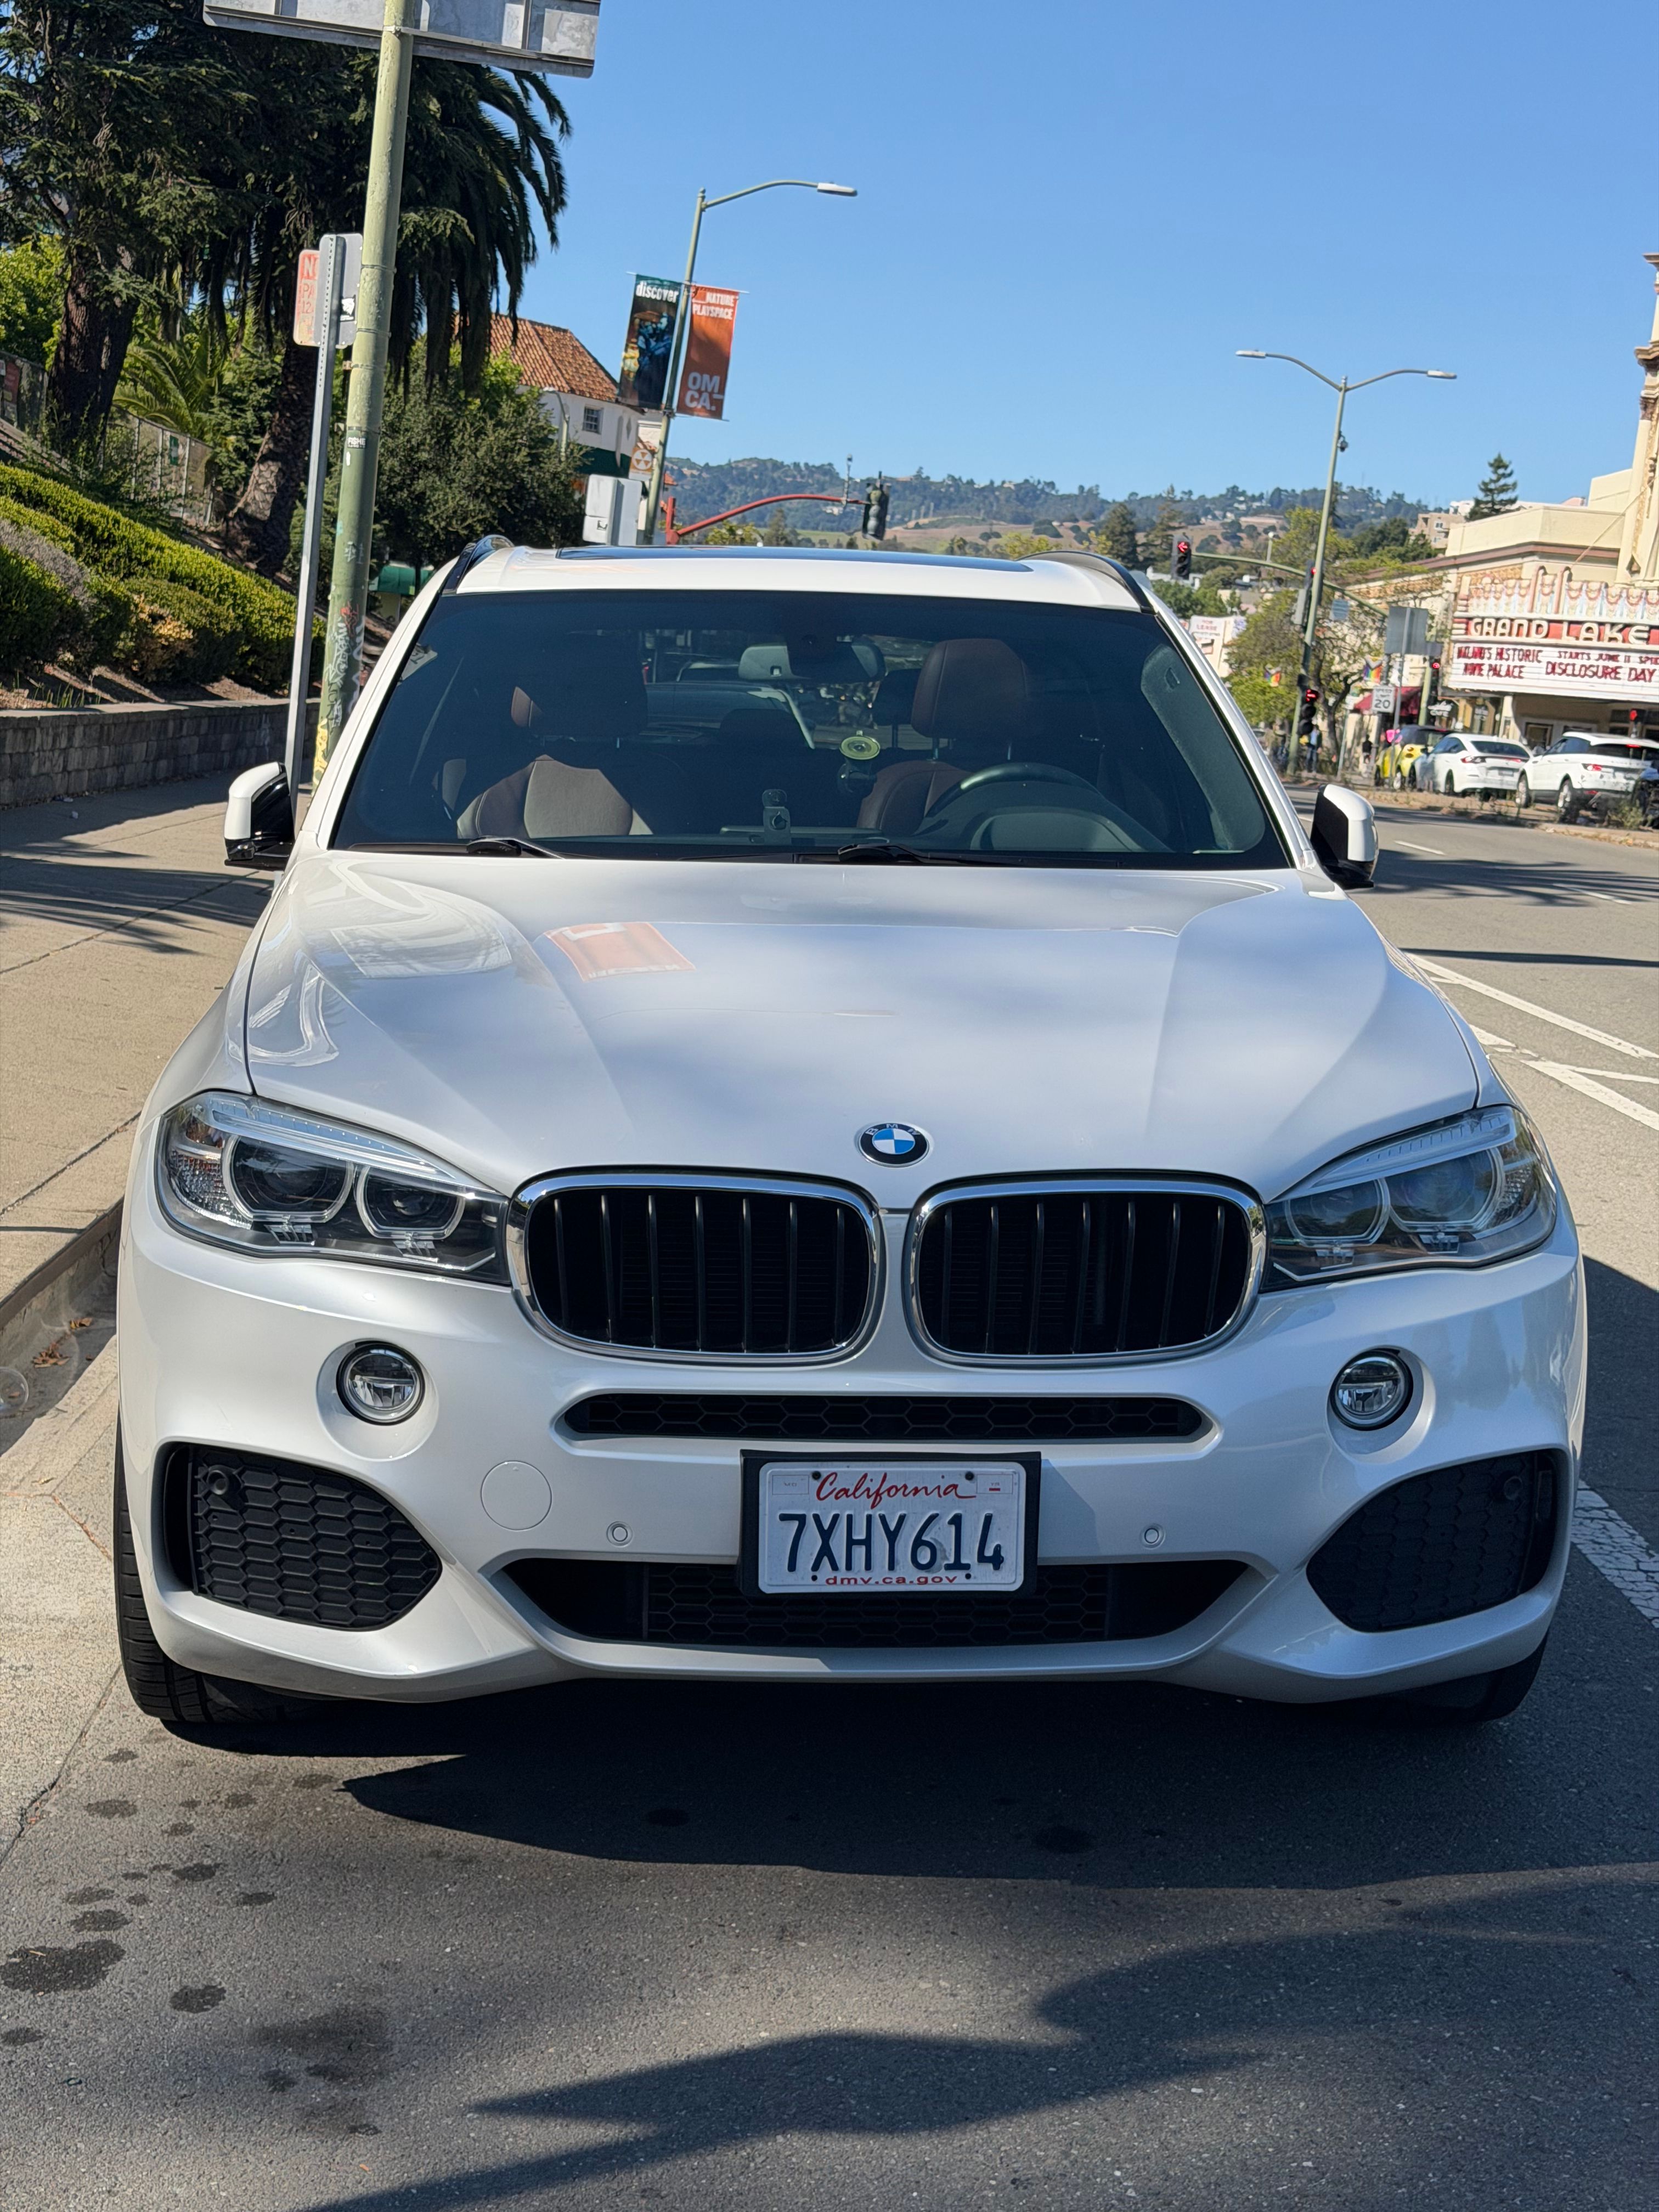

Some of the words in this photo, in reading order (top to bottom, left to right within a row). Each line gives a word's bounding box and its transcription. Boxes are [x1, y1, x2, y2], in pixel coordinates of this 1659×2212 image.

[636, 281, 679, 303] discover
[706, 291, 735, 307] NATURE
[693, 303, 733, 320] PLAYSPACE
[688, 372, 720, 393] OM
[1470, 618, 1549, 639] GRAND
[1562, 621, 1650, 645] LAKE
[1496, 647, 1543, 663] HISTORIC
[1558, 651, 1590, 661] STARTS
[1487, 663, 1526, 679] PALACE
[1545, 661, 1624, 680] DISCLOSURE
[1627, 667, 1657, 682] DAY
[1374, 699, 1391, 709] 20
[865, 1124, 921, 1136] BMW
[816, 1472, 976, 1509] California
[778, 1513, 1005, 1573] 7XHY614
[825, 1575, 958, 1585] dmv.ca.gov
